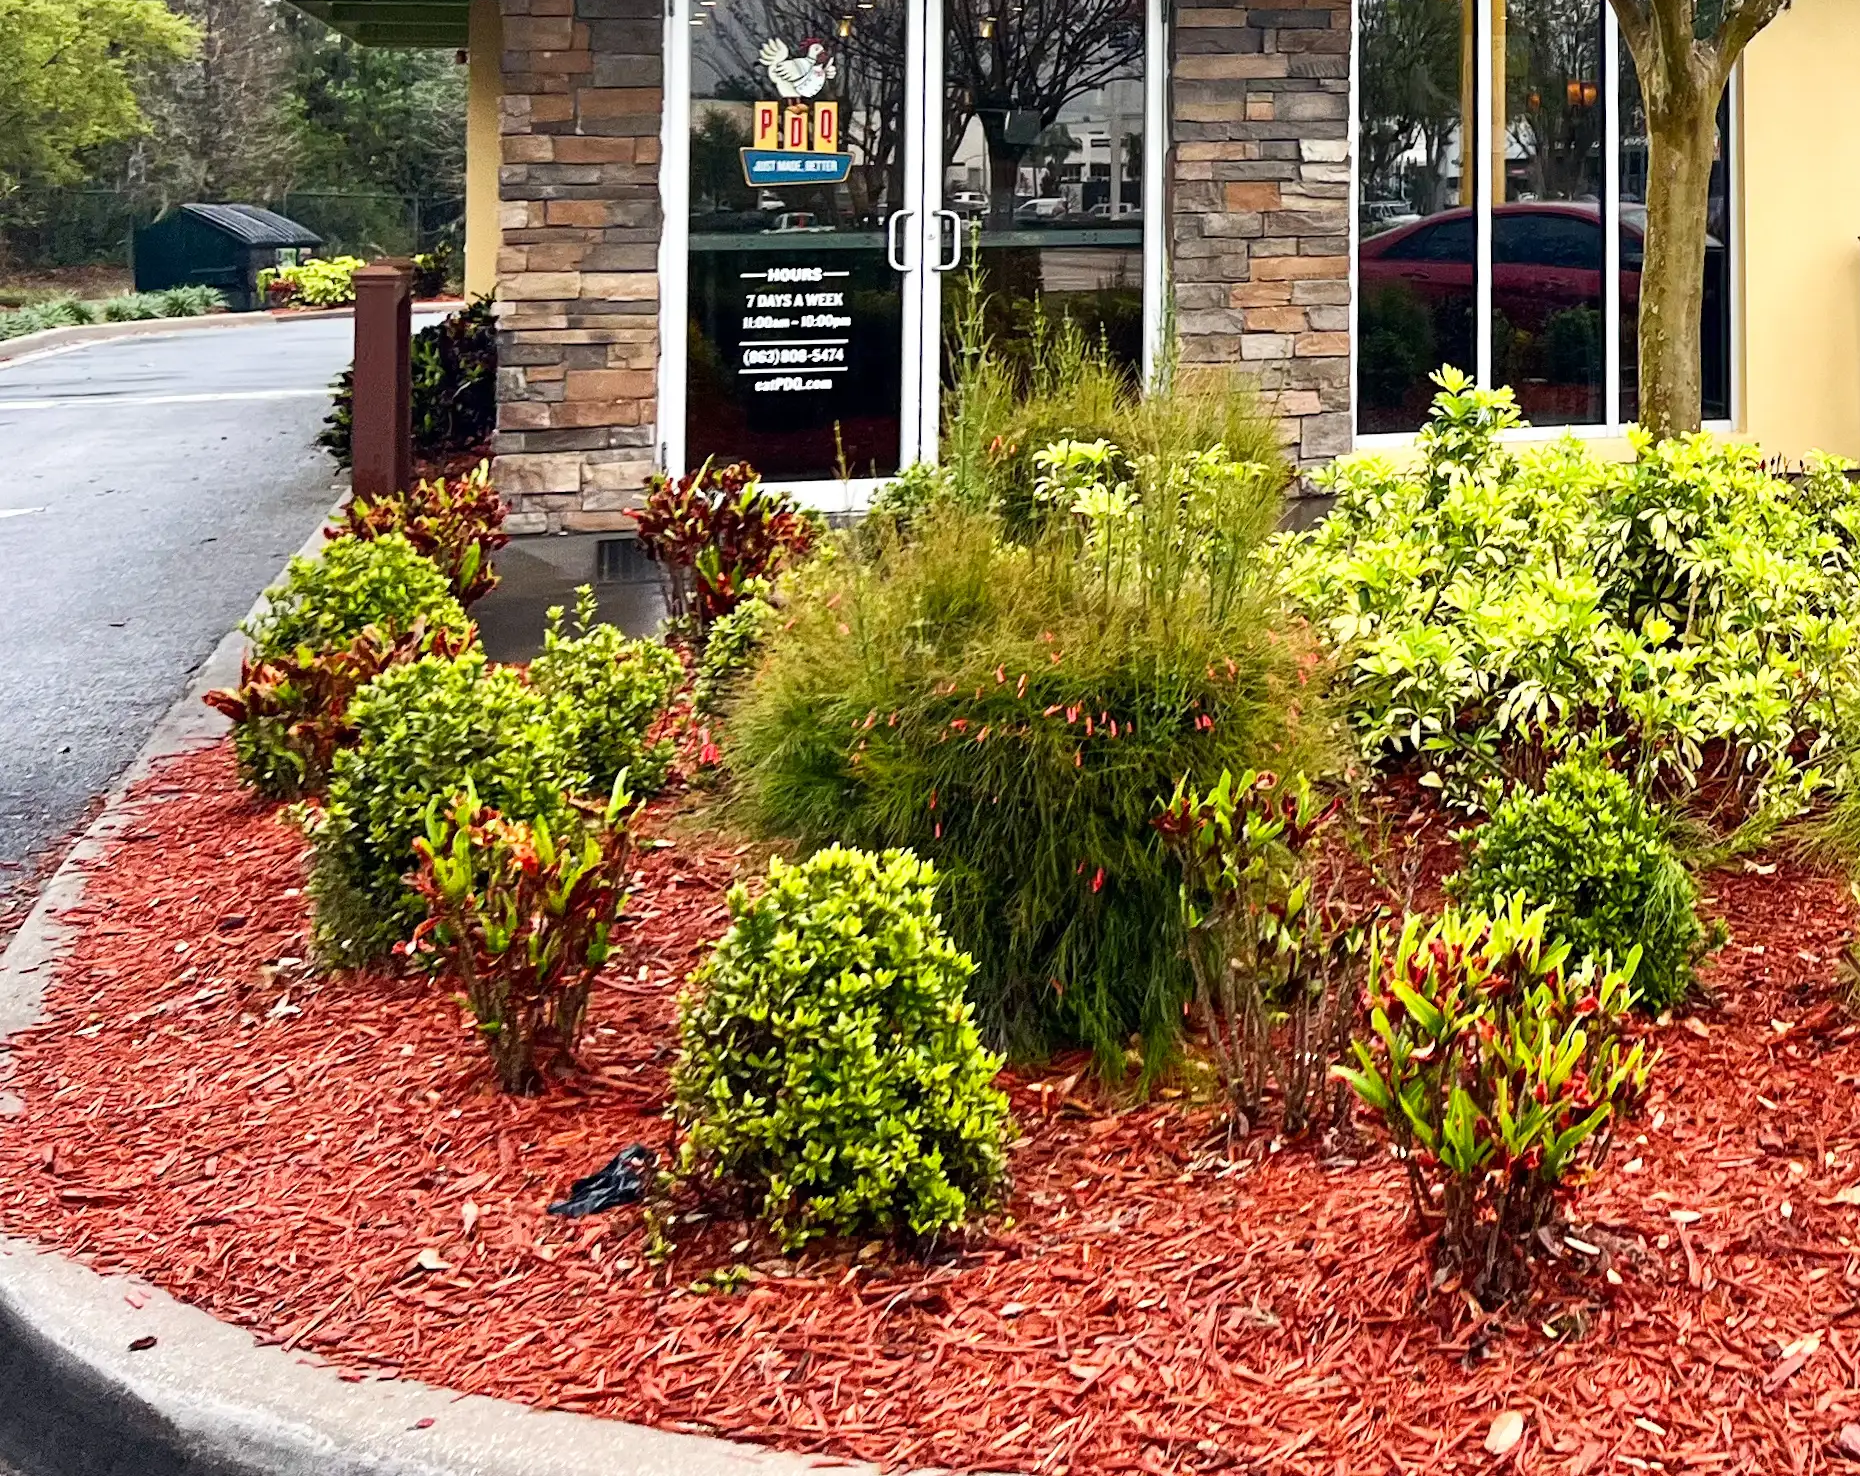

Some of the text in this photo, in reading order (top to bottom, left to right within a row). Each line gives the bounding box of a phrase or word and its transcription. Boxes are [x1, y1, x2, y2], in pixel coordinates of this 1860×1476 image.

[761, 109, 832, 147] PDQ
[767, 267, 823, 282] HOURS
[745, 292, 844, 308] 7 DAYS A WEEK
